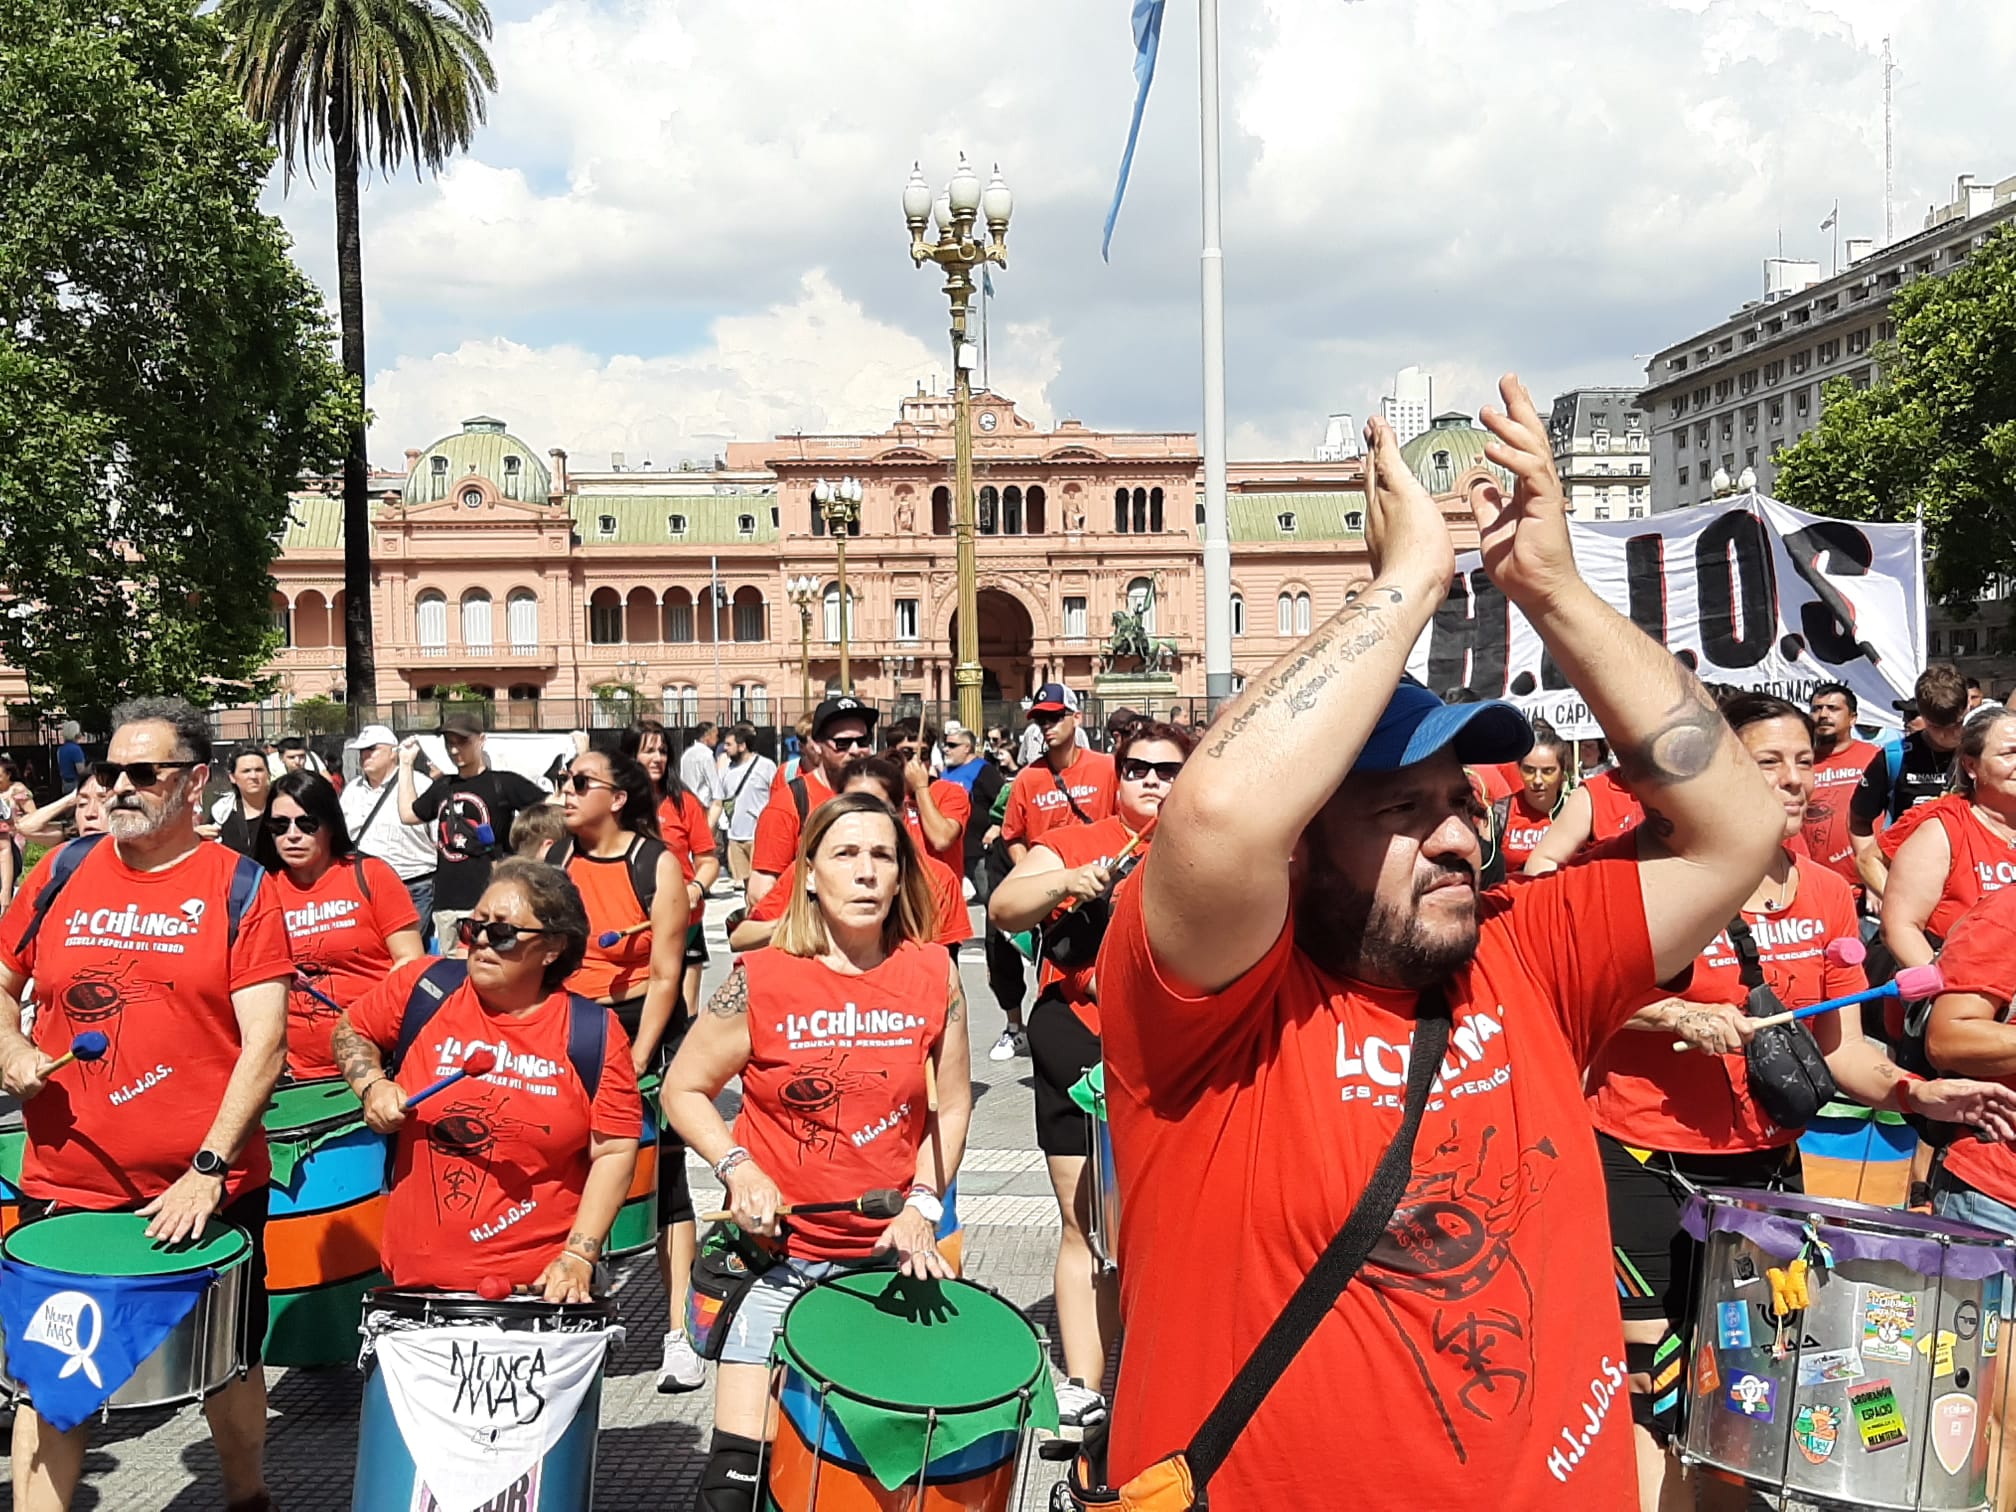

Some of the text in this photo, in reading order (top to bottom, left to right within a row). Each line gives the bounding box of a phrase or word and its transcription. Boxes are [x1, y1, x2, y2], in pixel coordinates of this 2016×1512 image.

[69, 904, 188, 937] LA CHILINGA
[285, 900, 354, 931] CHILINGA
[65, 936, 184, 953] ESCUELA POPULAR DEL TAMBOR
[786, 1002, 917, 1040] LA CHILINGA
[440, 1037, 461, 1064] LA
[789, 1039, 836, 1050] ESCUELA
[838, 1039, 853, 1048] DE
[109, 1064, 173, 1106] H.I.J.O.S.
[469, 1199, 537, 1242] H.I.J.O.S.
[46, 1321, 73, 1347] MAS
[450, 1340, 547, 1381] NUNCA
[452, 1379, 546, 1425] MAS
[1547, 1356, 1627, 1482] H.I.J.O.S.
